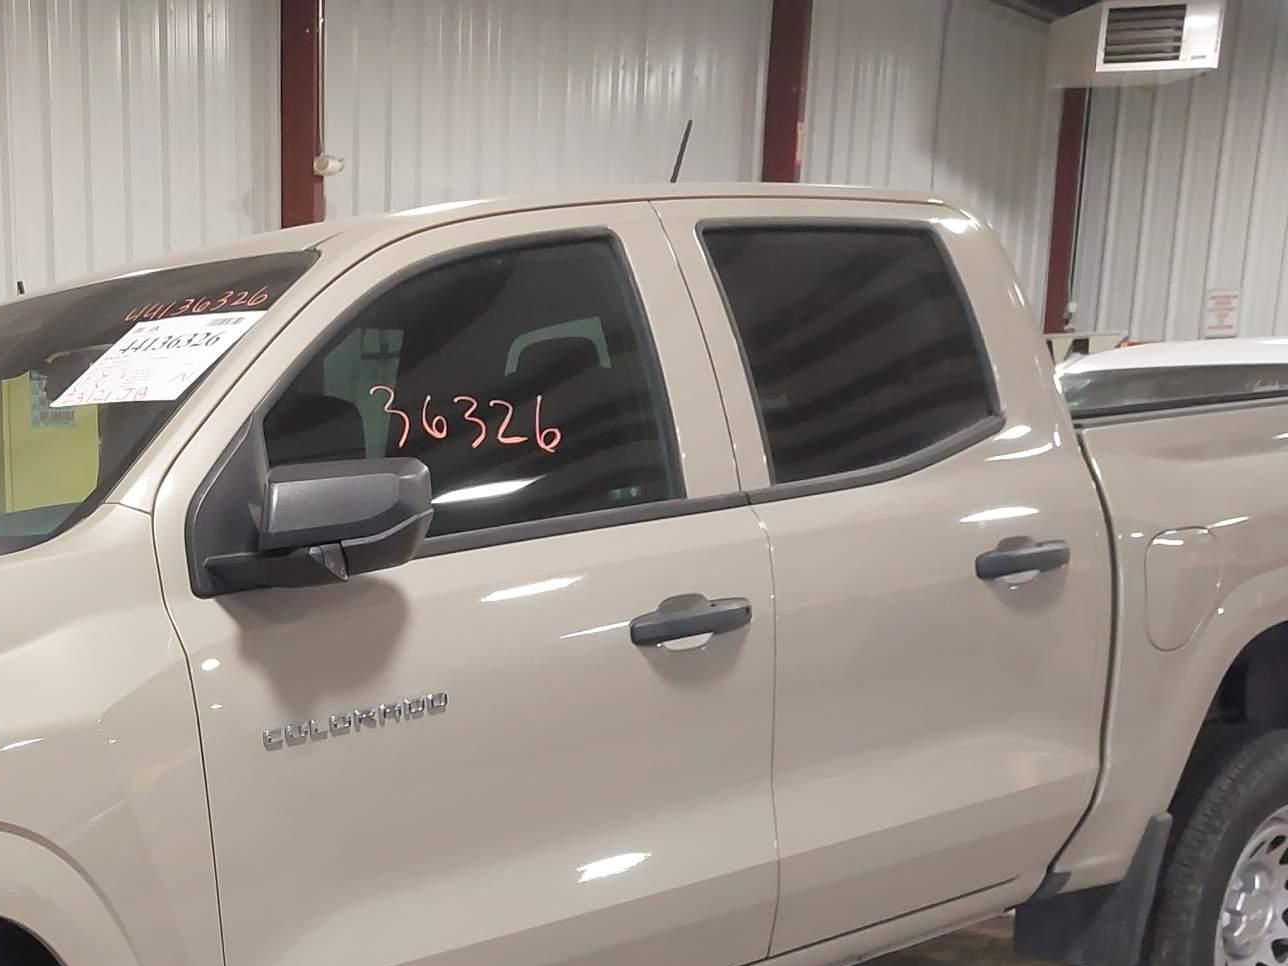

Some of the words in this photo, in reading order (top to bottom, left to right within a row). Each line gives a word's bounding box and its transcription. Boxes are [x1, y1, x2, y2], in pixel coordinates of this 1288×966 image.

[124, 286, 268, 321] 44136326
[119, 331, 223, 354] 44136326
[369, 384, 562, 453] 36326
[262, 692, 448, 750] COLORADO
